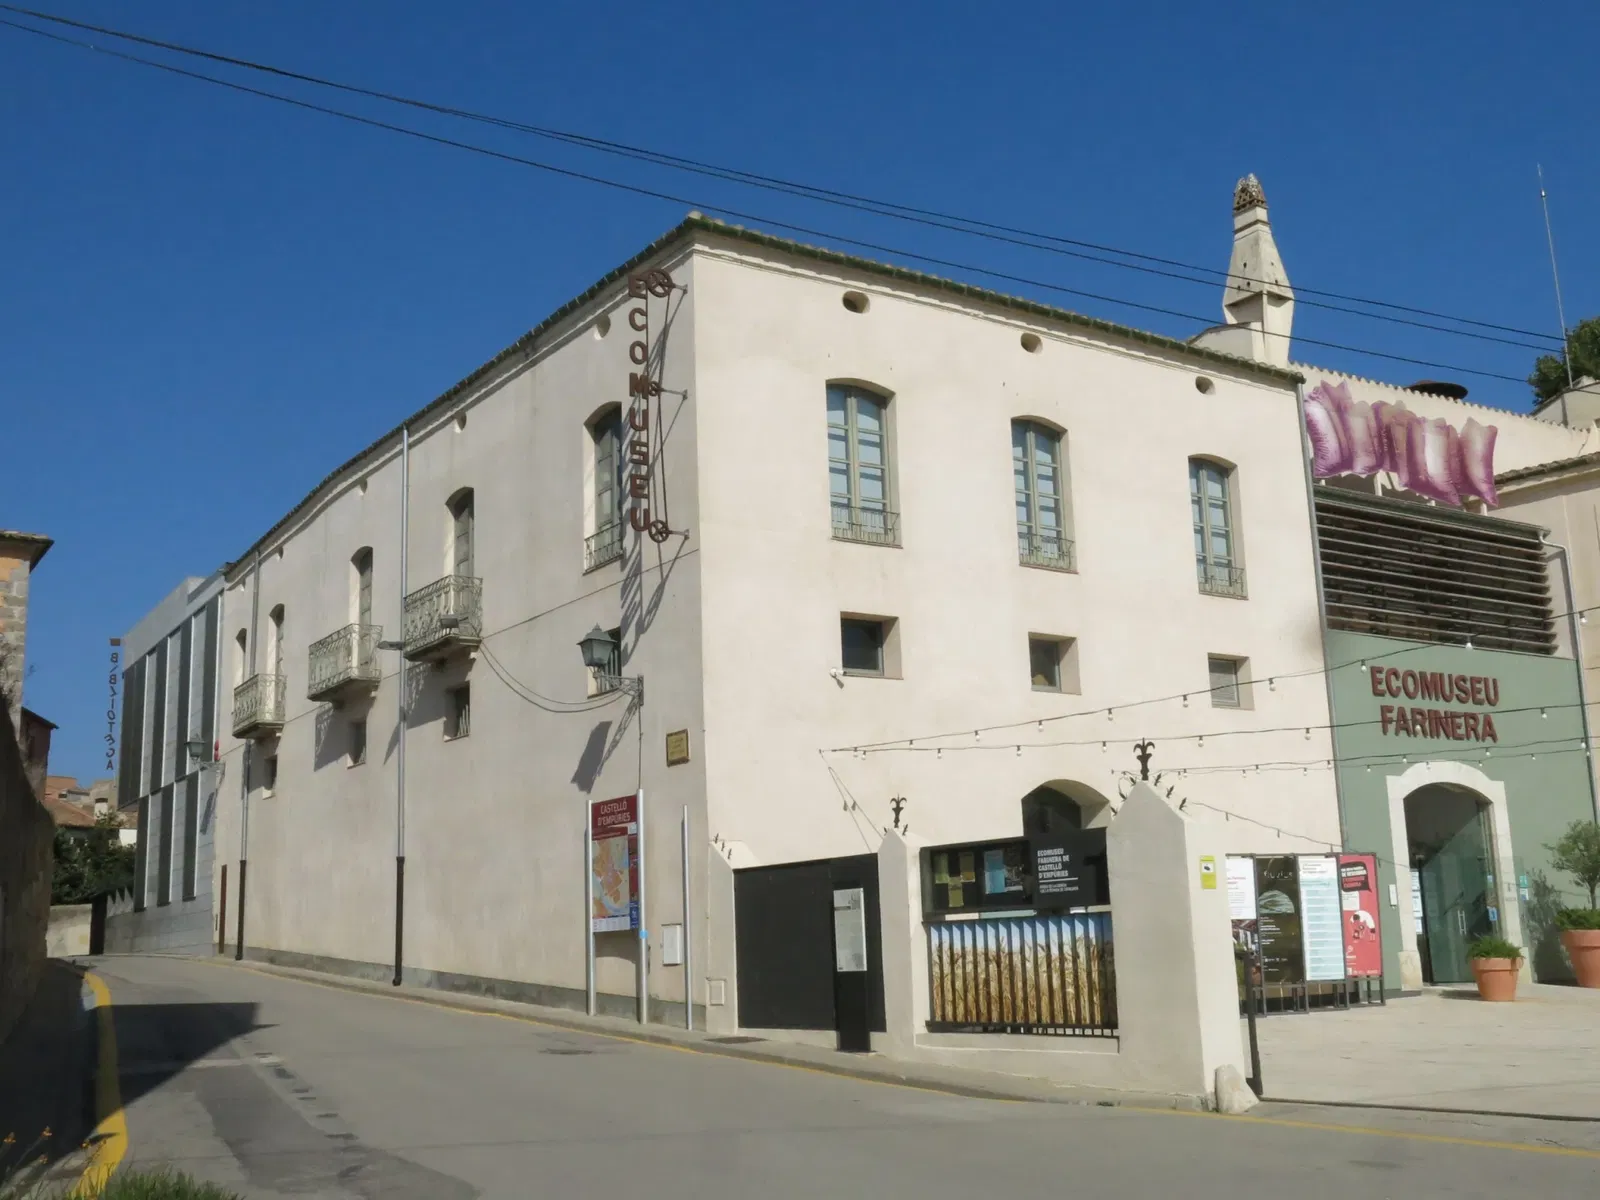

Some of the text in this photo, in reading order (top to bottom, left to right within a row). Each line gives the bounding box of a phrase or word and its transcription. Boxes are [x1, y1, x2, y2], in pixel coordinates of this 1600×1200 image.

[628, 274, 650, 533] ECOMUSEU
[1370, 667, 1499, 706] ECOMUSEU
[1380, 704, 1499, 743] FARINERA
[600, 800, 627, 814] CASTELLÓ
[1037, 848, 1064, 856] ECOMUSEU
[1038, 863, 1063, 871] CASTELLÓ
